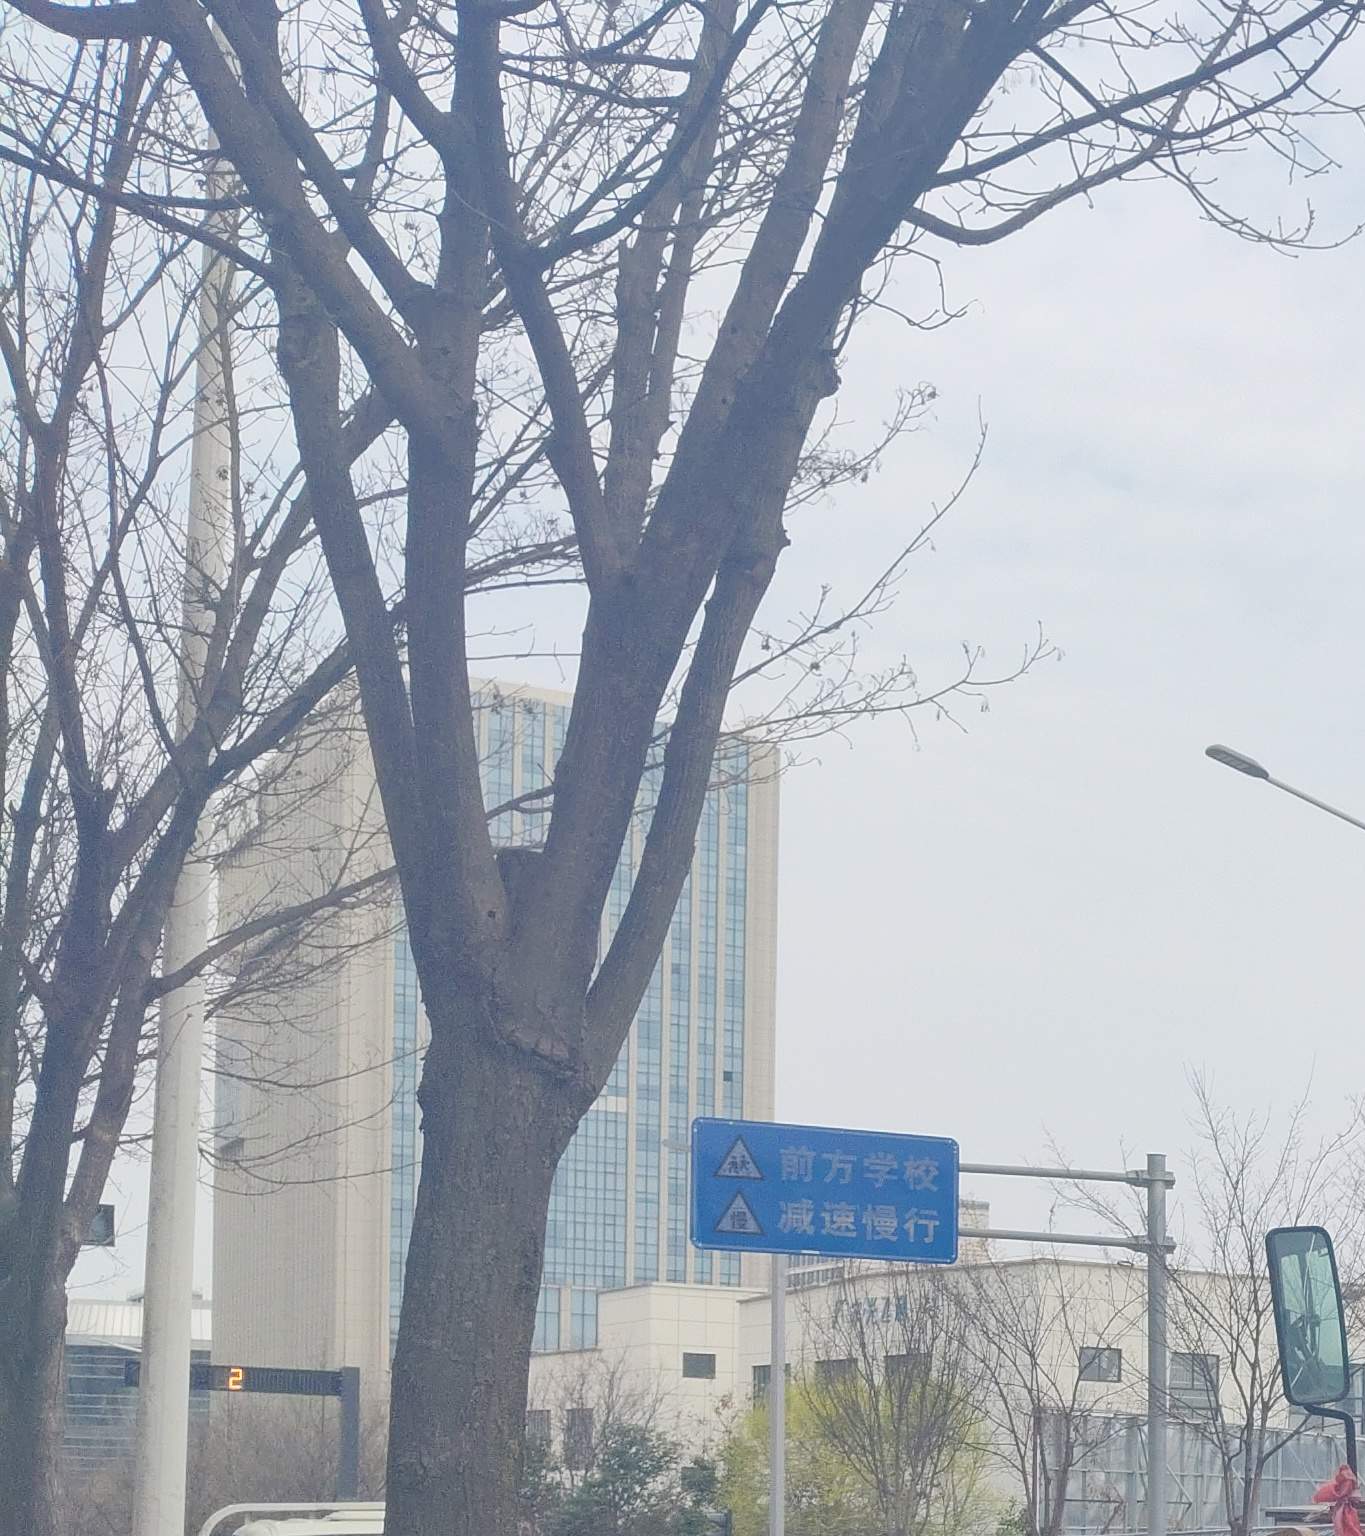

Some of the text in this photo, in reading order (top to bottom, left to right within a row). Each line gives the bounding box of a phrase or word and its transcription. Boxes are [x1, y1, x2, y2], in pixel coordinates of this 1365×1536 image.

[779, 1147, 939, 1192] 前方学校
[777, 1198, 940, 1244] 减速慢行
